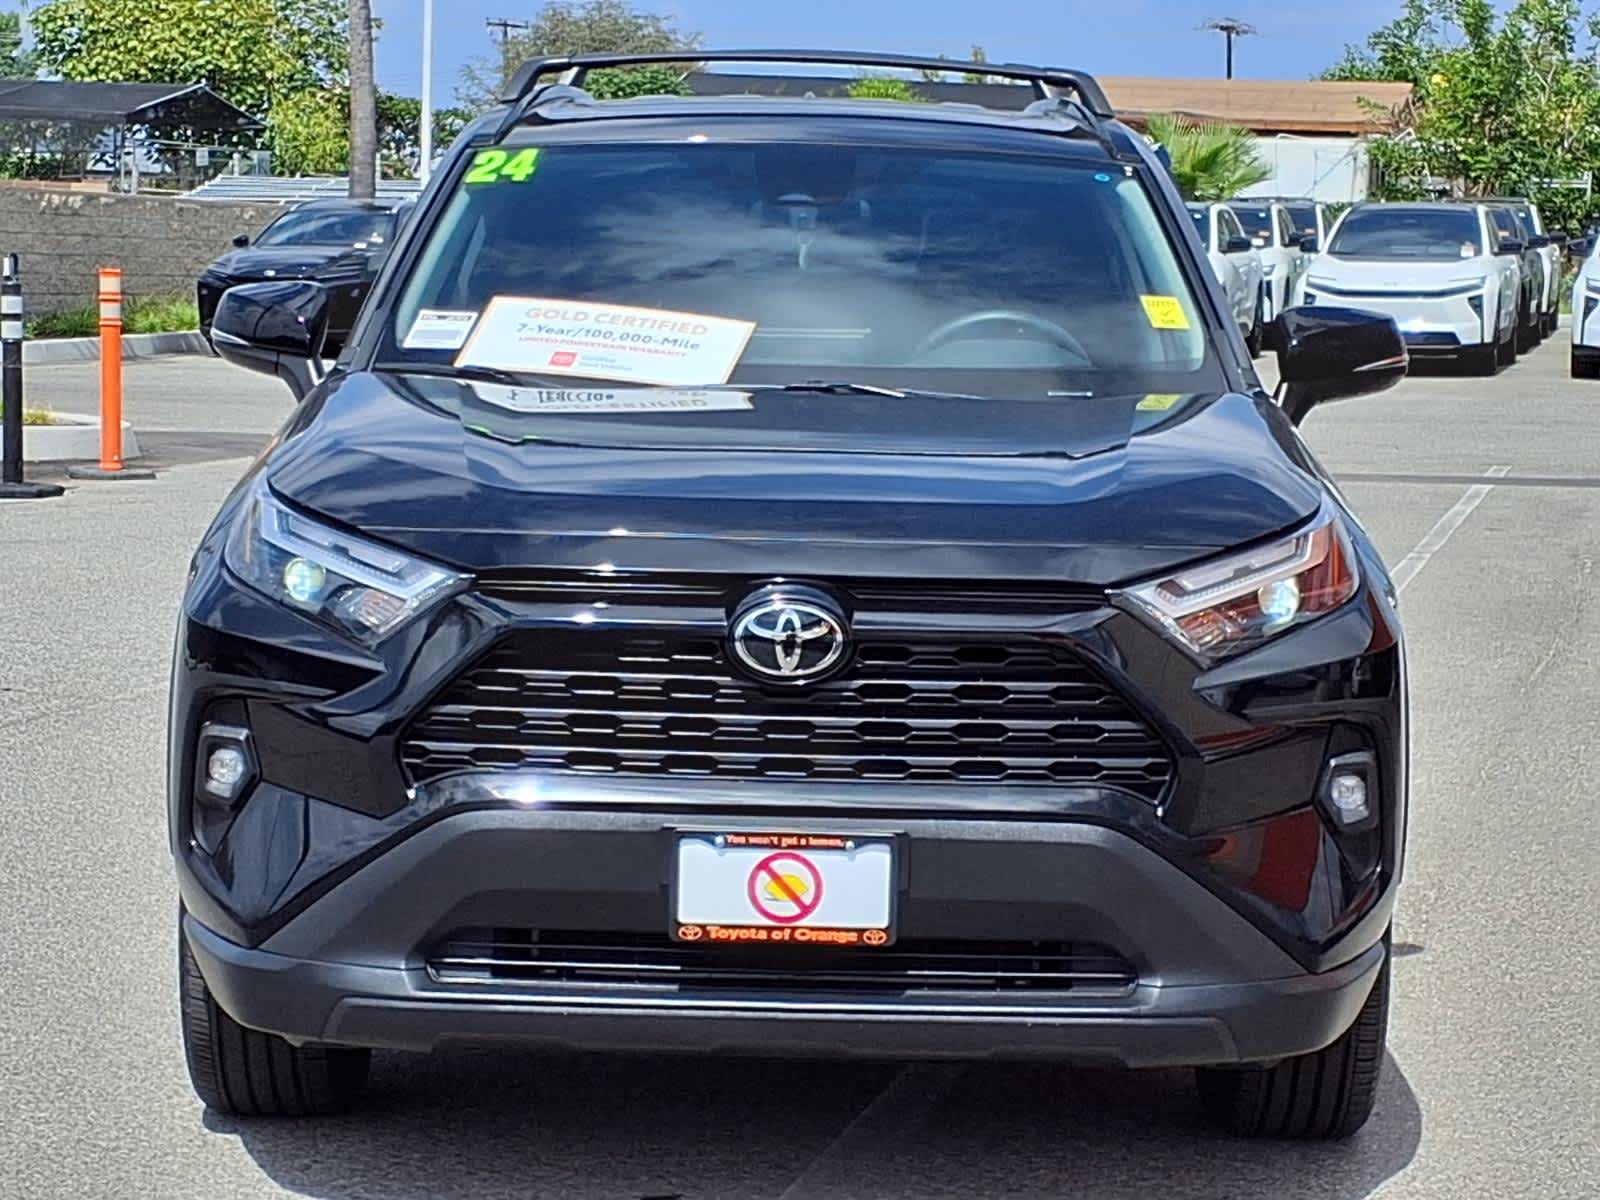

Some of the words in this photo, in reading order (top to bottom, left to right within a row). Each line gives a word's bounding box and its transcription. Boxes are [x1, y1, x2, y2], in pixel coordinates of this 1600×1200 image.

[464, 147, 539, 184] 24
[526, 308, 589, 321] GOLD
[593, 312, 708, 336] CERTIFIED
[516, 322, 701, 351] 7-Year/100,000-Mile
[706, 926, 768, 941] Toyota
[771, 929, 790, 940] of
[794, 929, 859, 943] Orange
